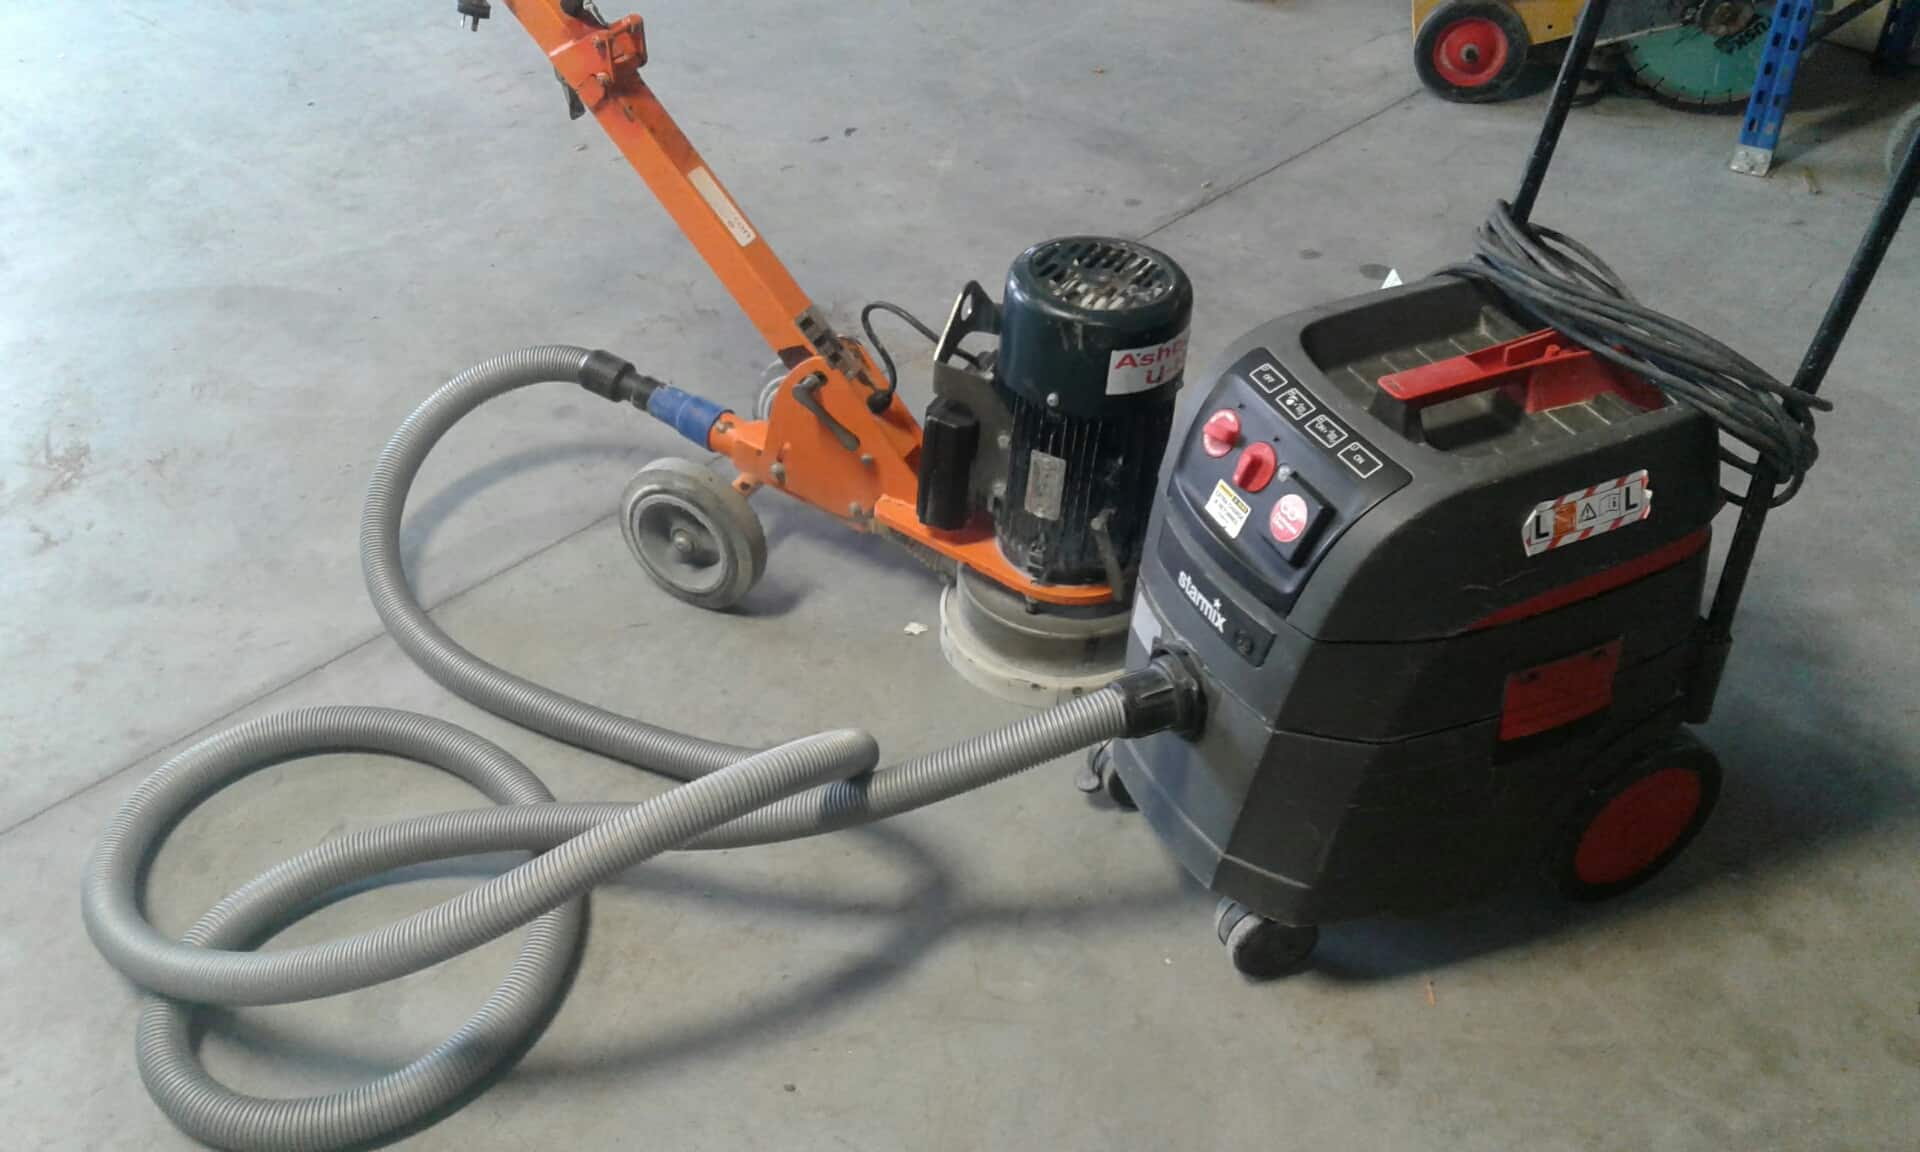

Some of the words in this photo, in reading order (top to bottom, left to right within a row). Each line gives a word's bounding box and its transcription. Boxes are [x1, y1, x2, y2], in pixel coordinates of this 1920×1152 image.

[1535, 515, 1550, 540] L
[1625, 486, 1638, 511] L
[1178, 570, 1227, 634] starmix
